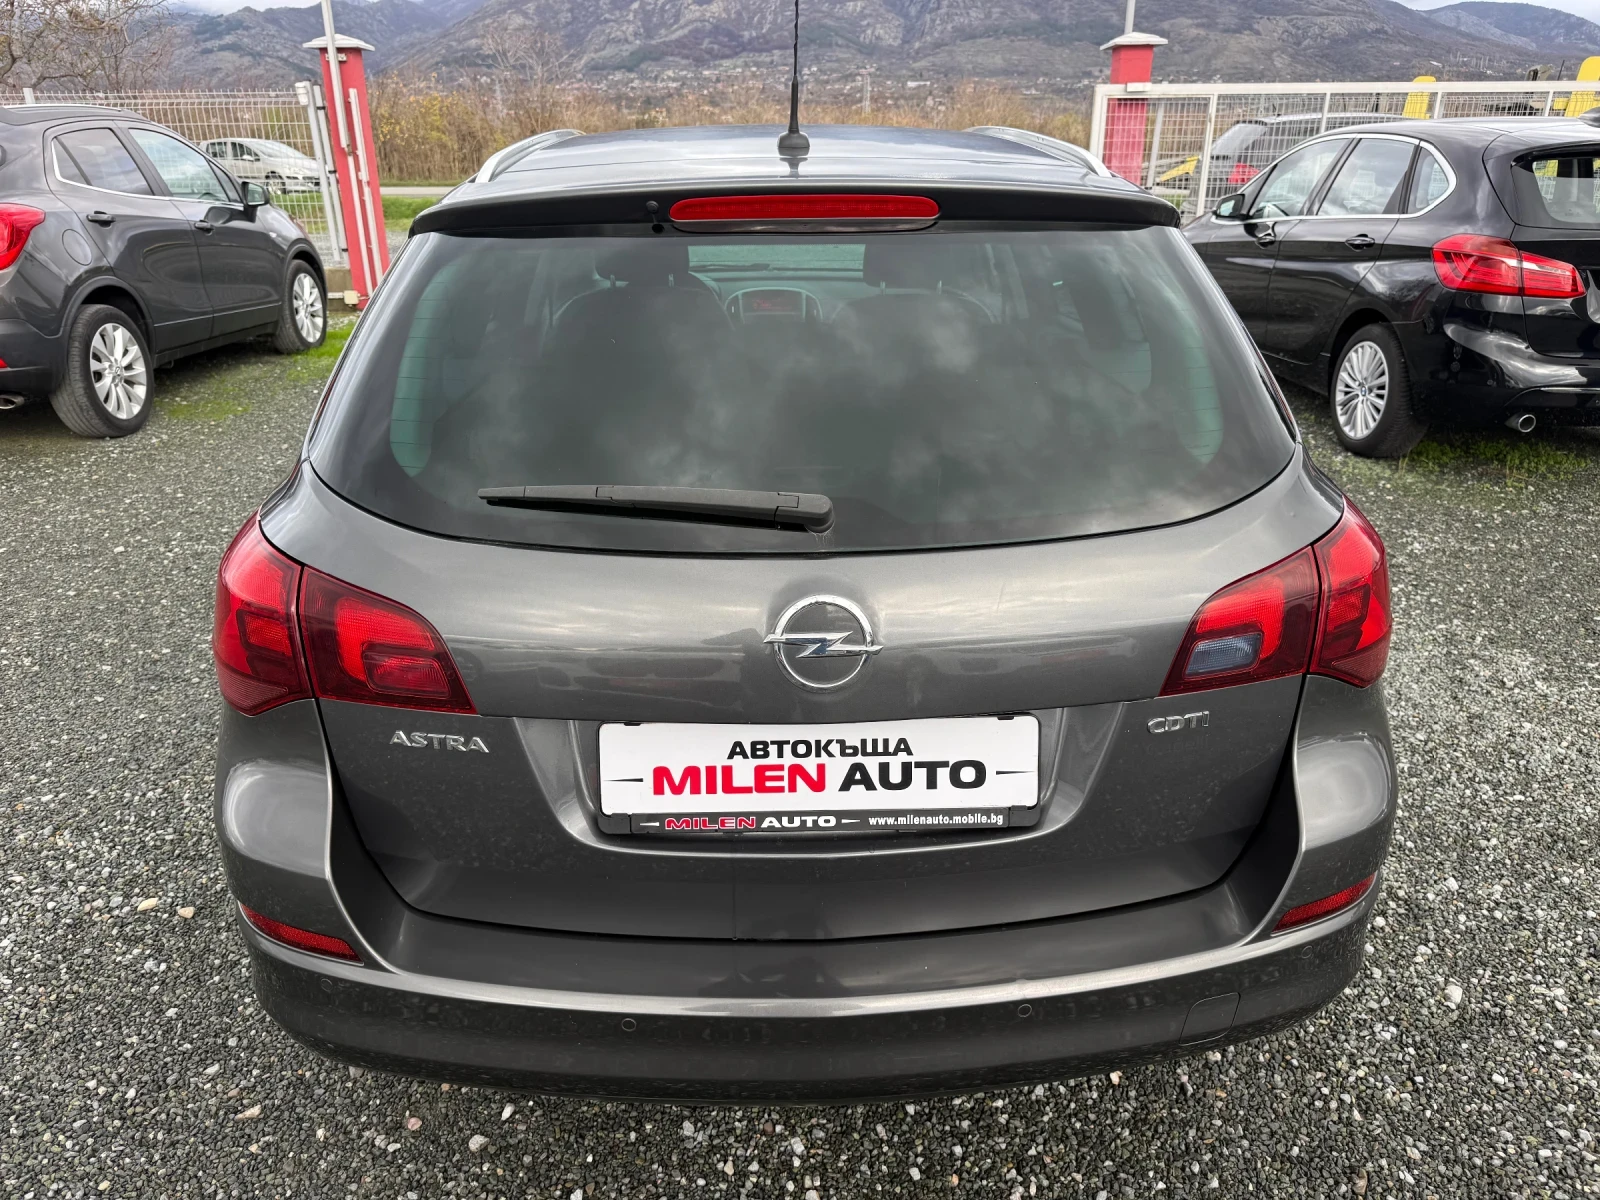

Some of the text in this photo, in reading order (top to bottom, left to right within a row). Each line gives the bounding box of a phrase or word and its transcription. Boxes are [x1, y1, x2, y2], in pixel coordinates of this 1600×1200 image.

[389, 729, 490, 753] ASTRA
[652, 759, 987, 796] MILEN AUTO
[664, 812, 1004, 830] MILEN AUTO www.milenauto.mobile.bg
